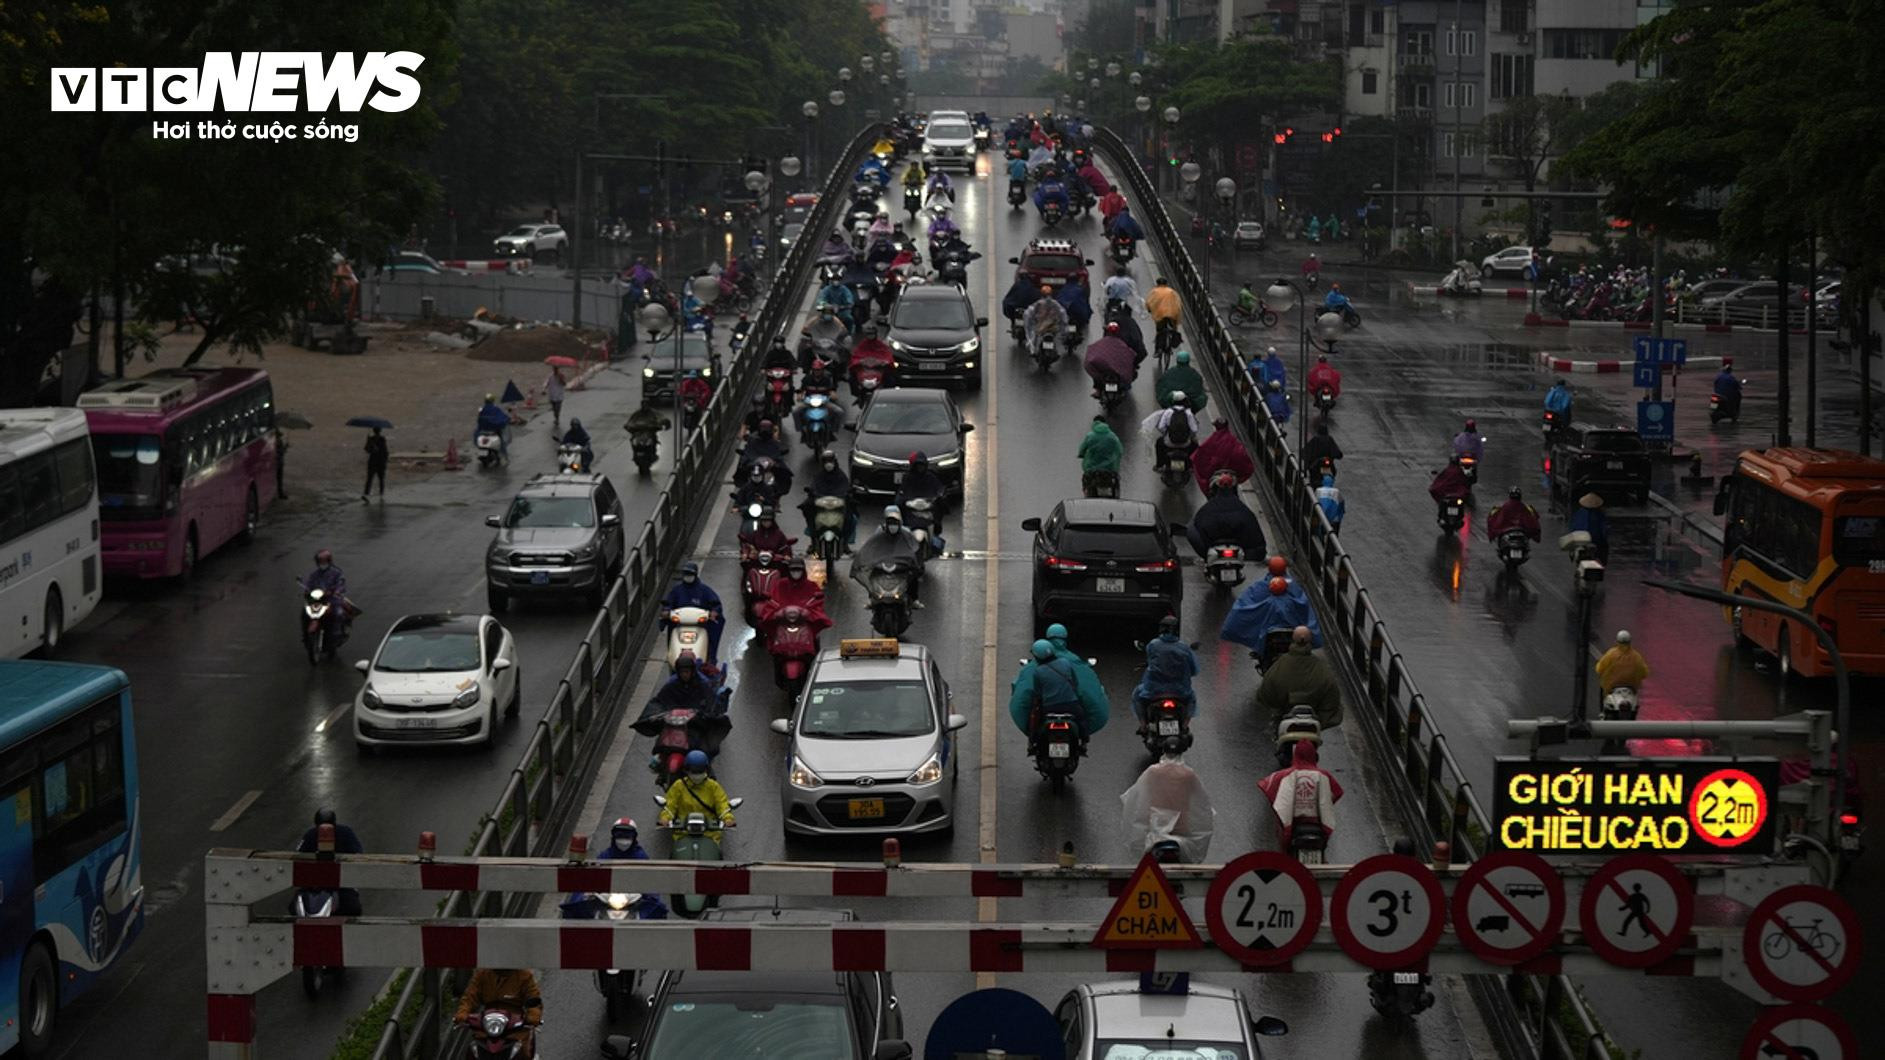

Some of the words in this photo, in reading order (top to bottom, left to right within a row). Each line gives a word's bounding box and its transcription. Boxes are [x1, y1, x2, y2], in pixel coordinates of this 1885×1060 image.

[1508, 767, 1594, 805] GIỚI
[1604, 773, 1683, 806] HẠN
[1138, 891, 1159, 910] ĐI
[1236, 885, 1294, 931] 2,2m
[1367, 890, 1413, 937] 3t
[1116, 912, 1178, 939] CHẬM
